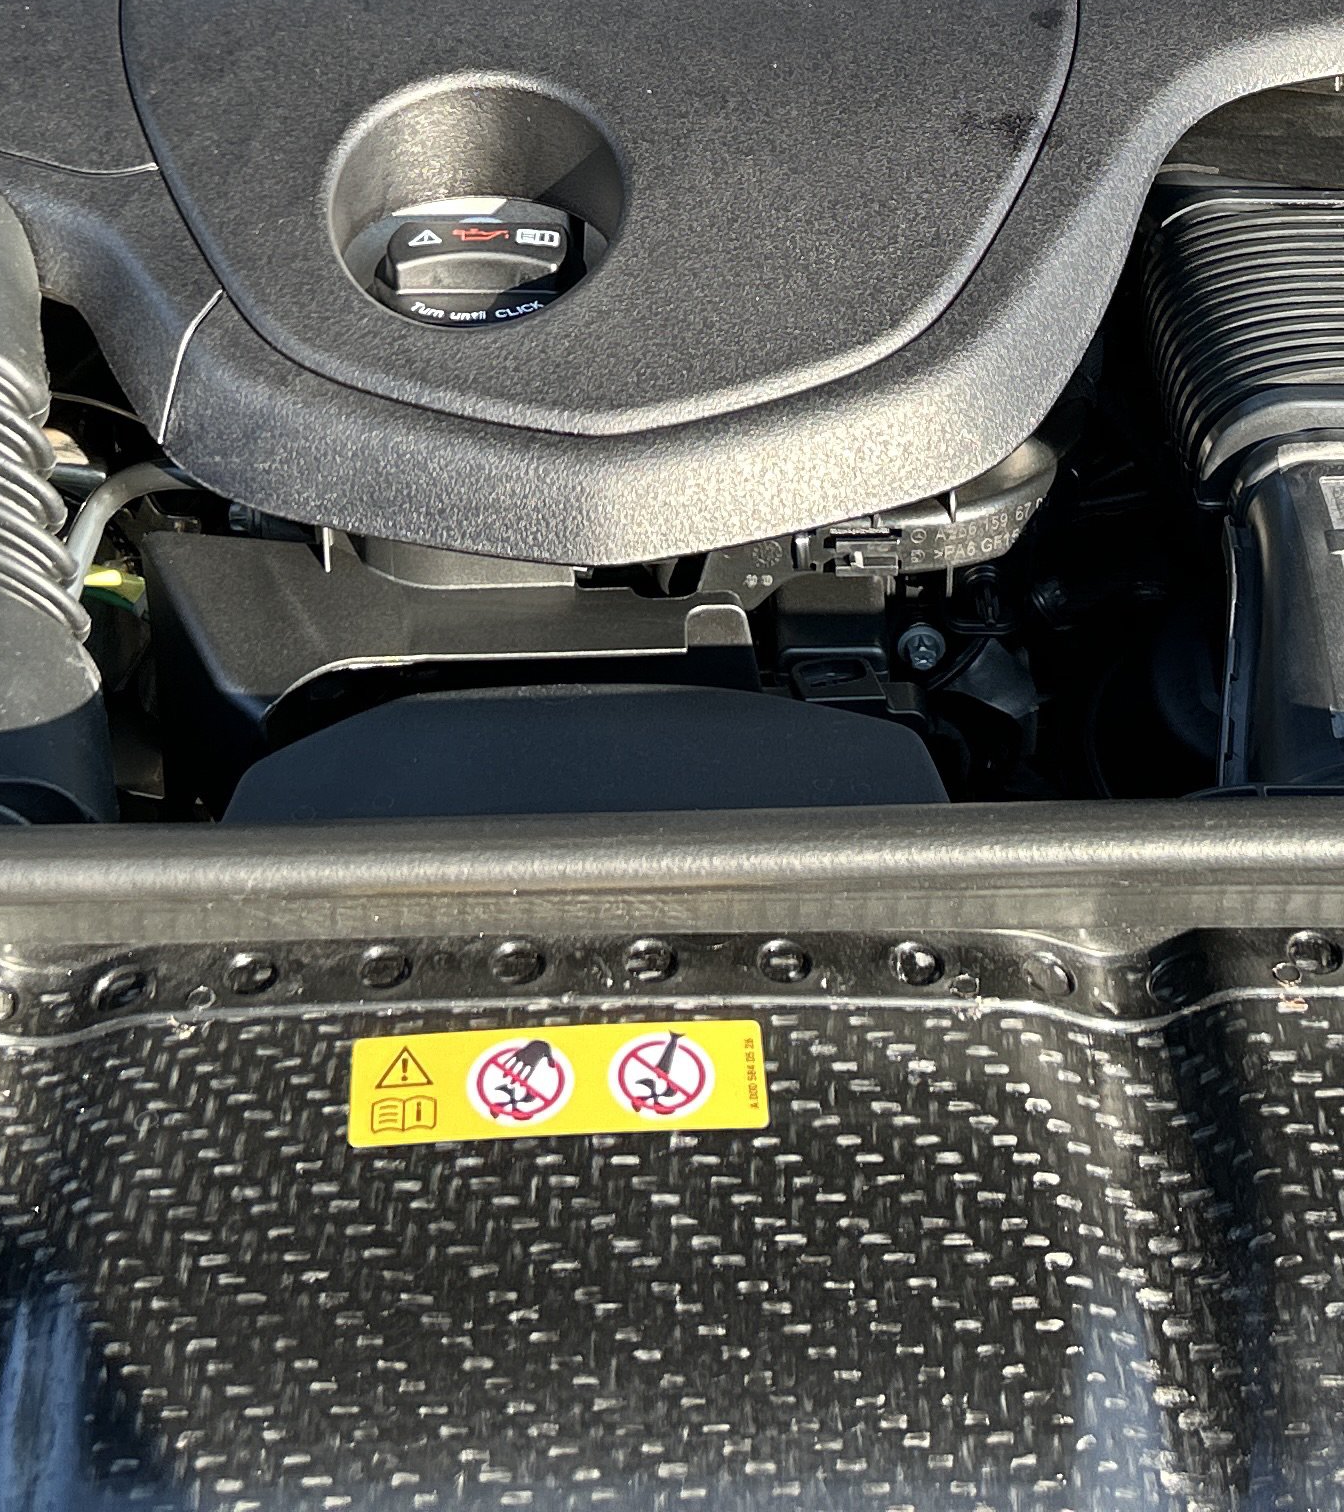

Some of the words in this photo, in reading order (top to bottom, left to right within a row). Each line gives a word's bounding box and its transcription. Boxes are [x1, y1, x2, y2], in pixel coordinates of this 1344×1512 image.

[410, 301, 445, 319] Turn
[449, 310, 487, 321] until
[495, 300, 544, 319] CLICK
[984, 512, 1008, 531] 159
